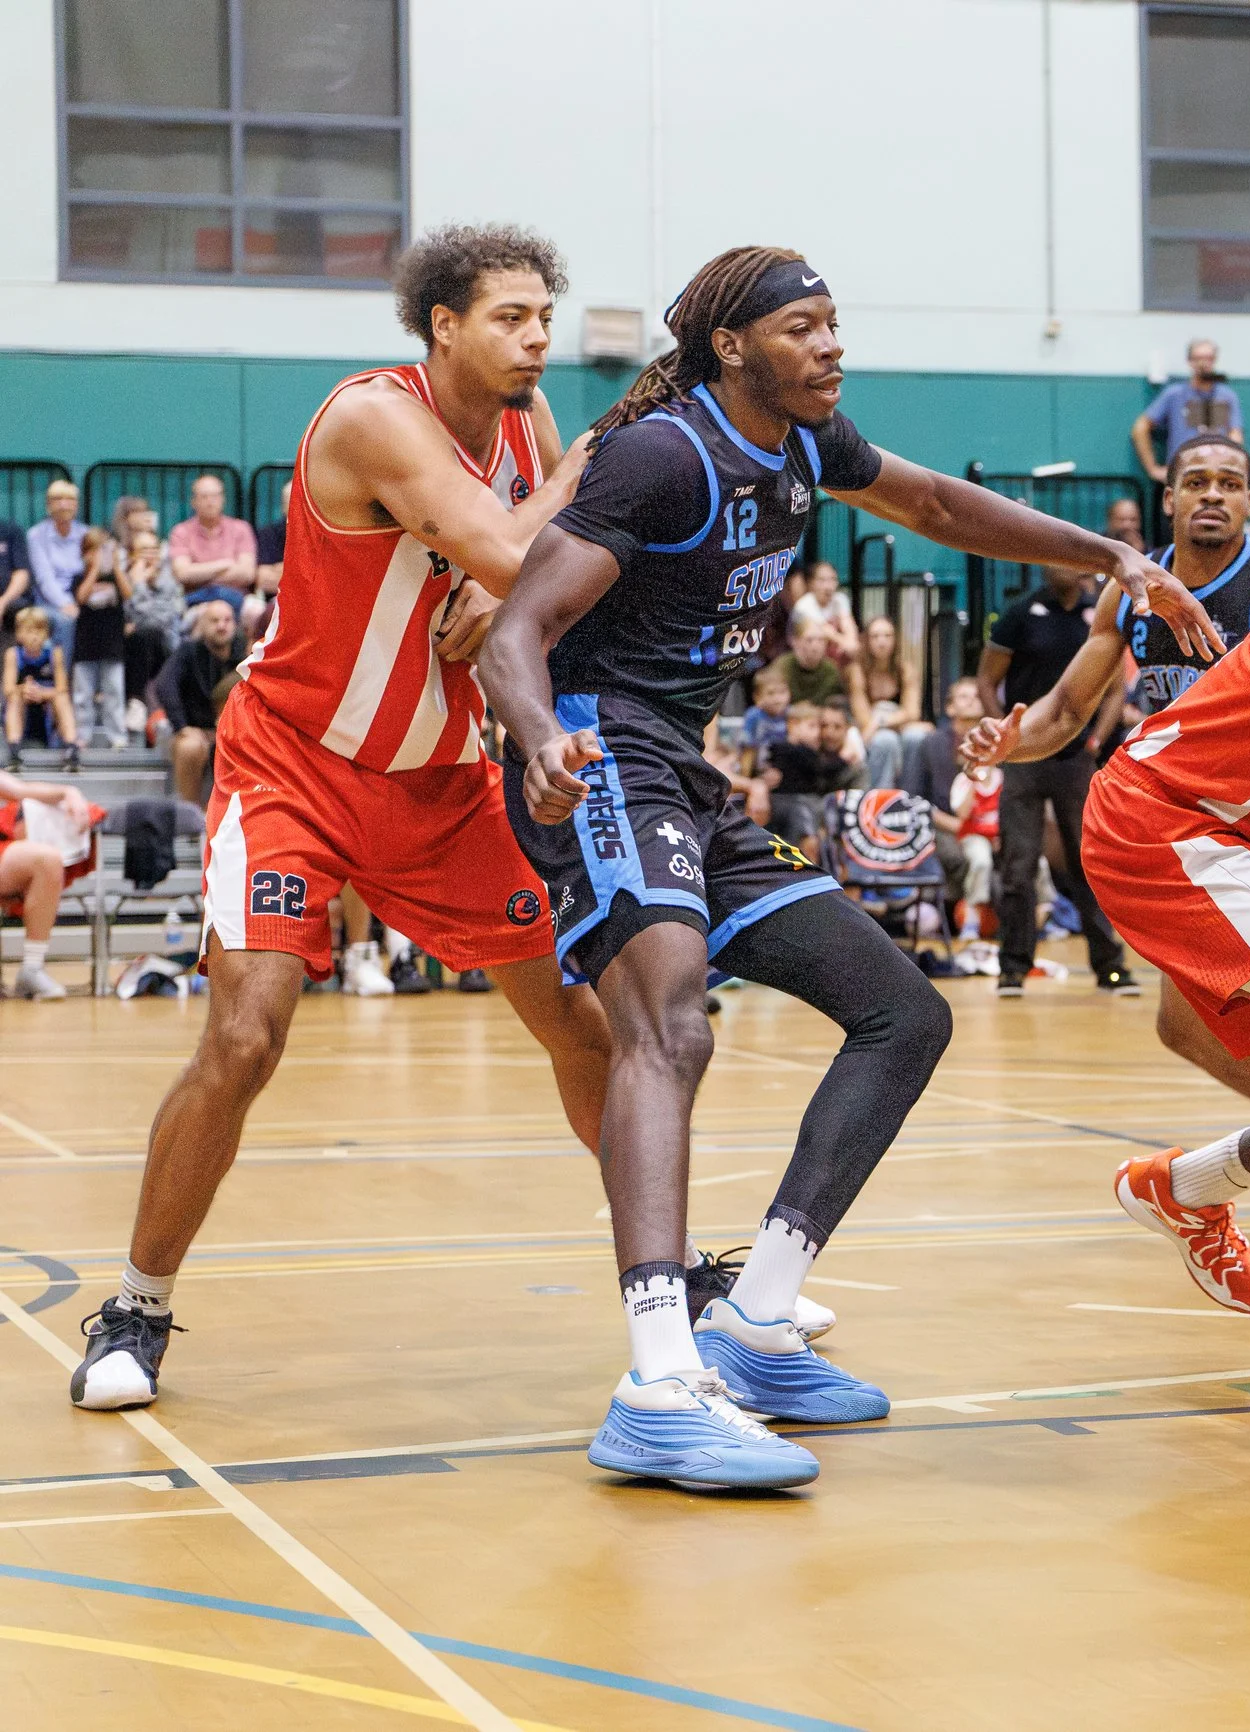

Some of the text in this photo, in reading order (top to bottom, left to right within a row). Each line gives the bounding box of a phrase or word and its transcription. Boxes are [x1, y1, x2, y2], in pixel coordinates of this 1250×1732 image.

[733, 484, 757, 498] TMB
[722, 499, 759, 550] 12
[250, 870, 307, 921] 22
[633, 1295, 678, 1310] DRIPPY
[634, 1301, 678, 1317] GRIPPY
